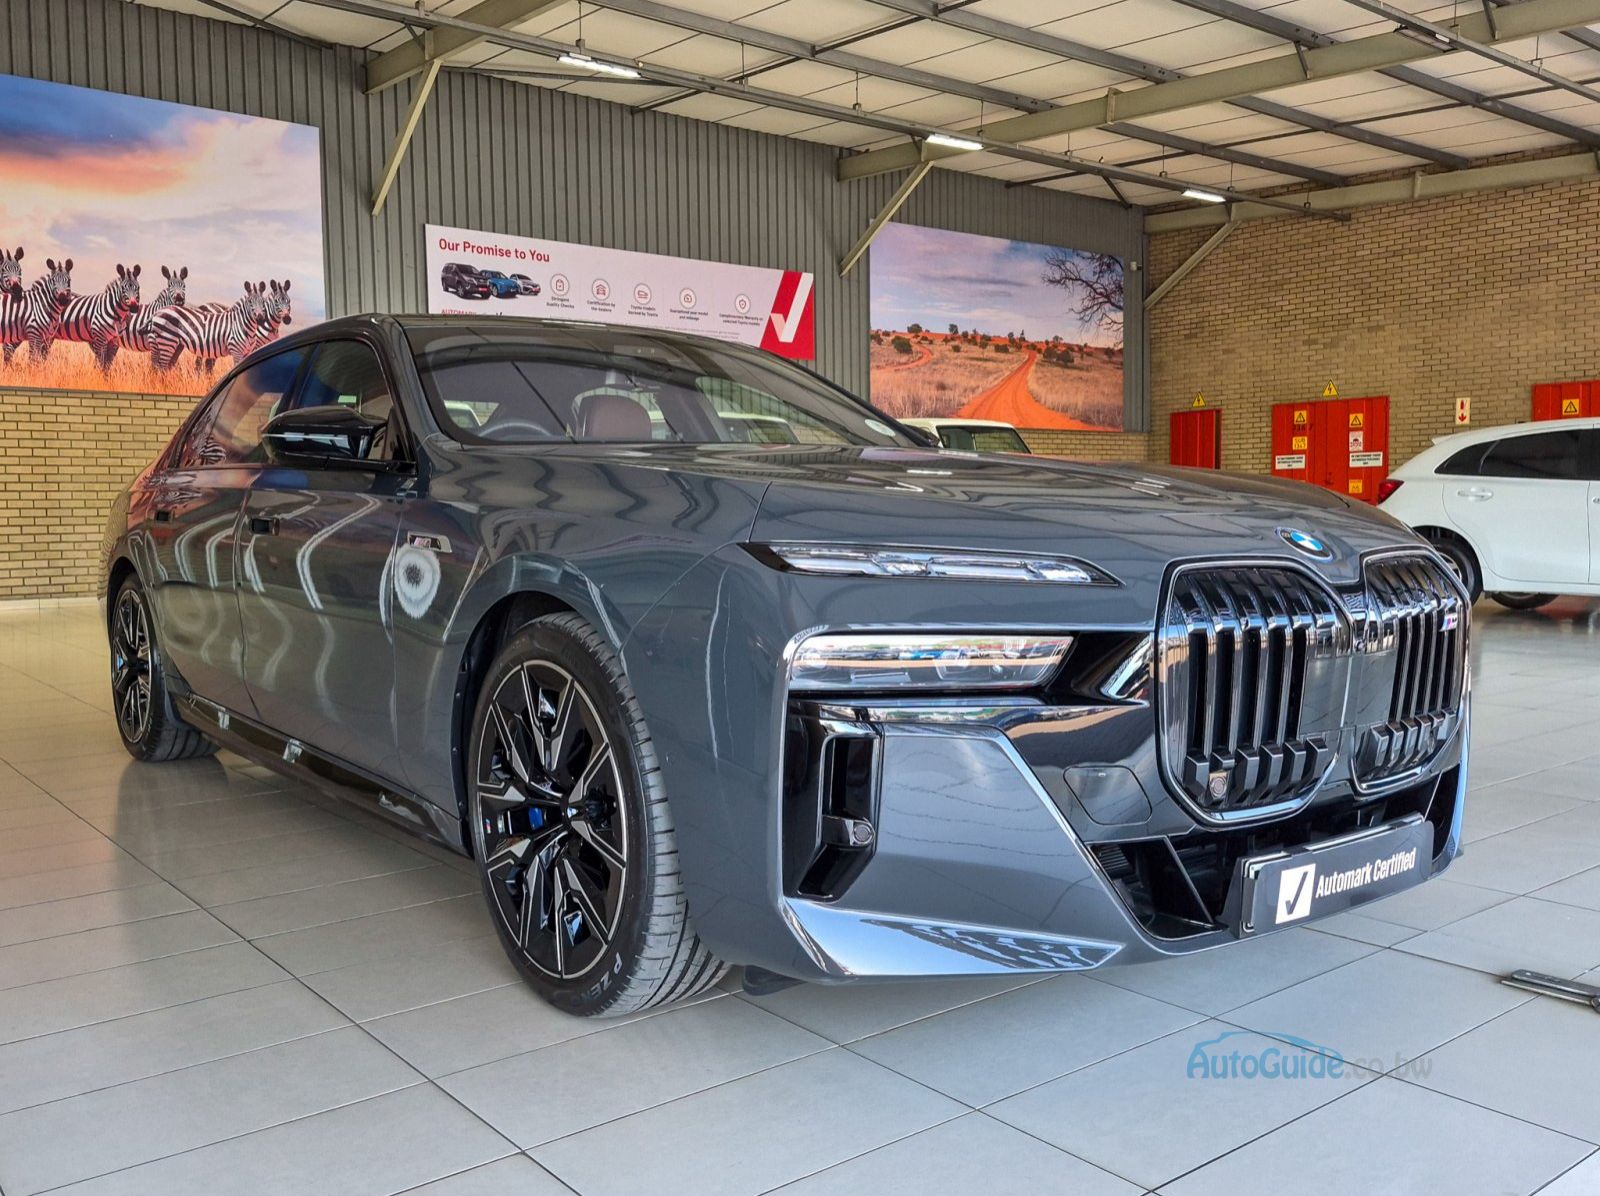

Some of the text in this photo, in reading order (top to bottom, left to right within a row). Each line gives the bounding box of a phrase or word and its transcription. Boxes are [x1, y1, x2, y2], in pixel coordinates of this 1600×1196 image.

[438, 238, 550, 263] Our Promise to You
[1315, 847, 1417, 899] Automark Certified
